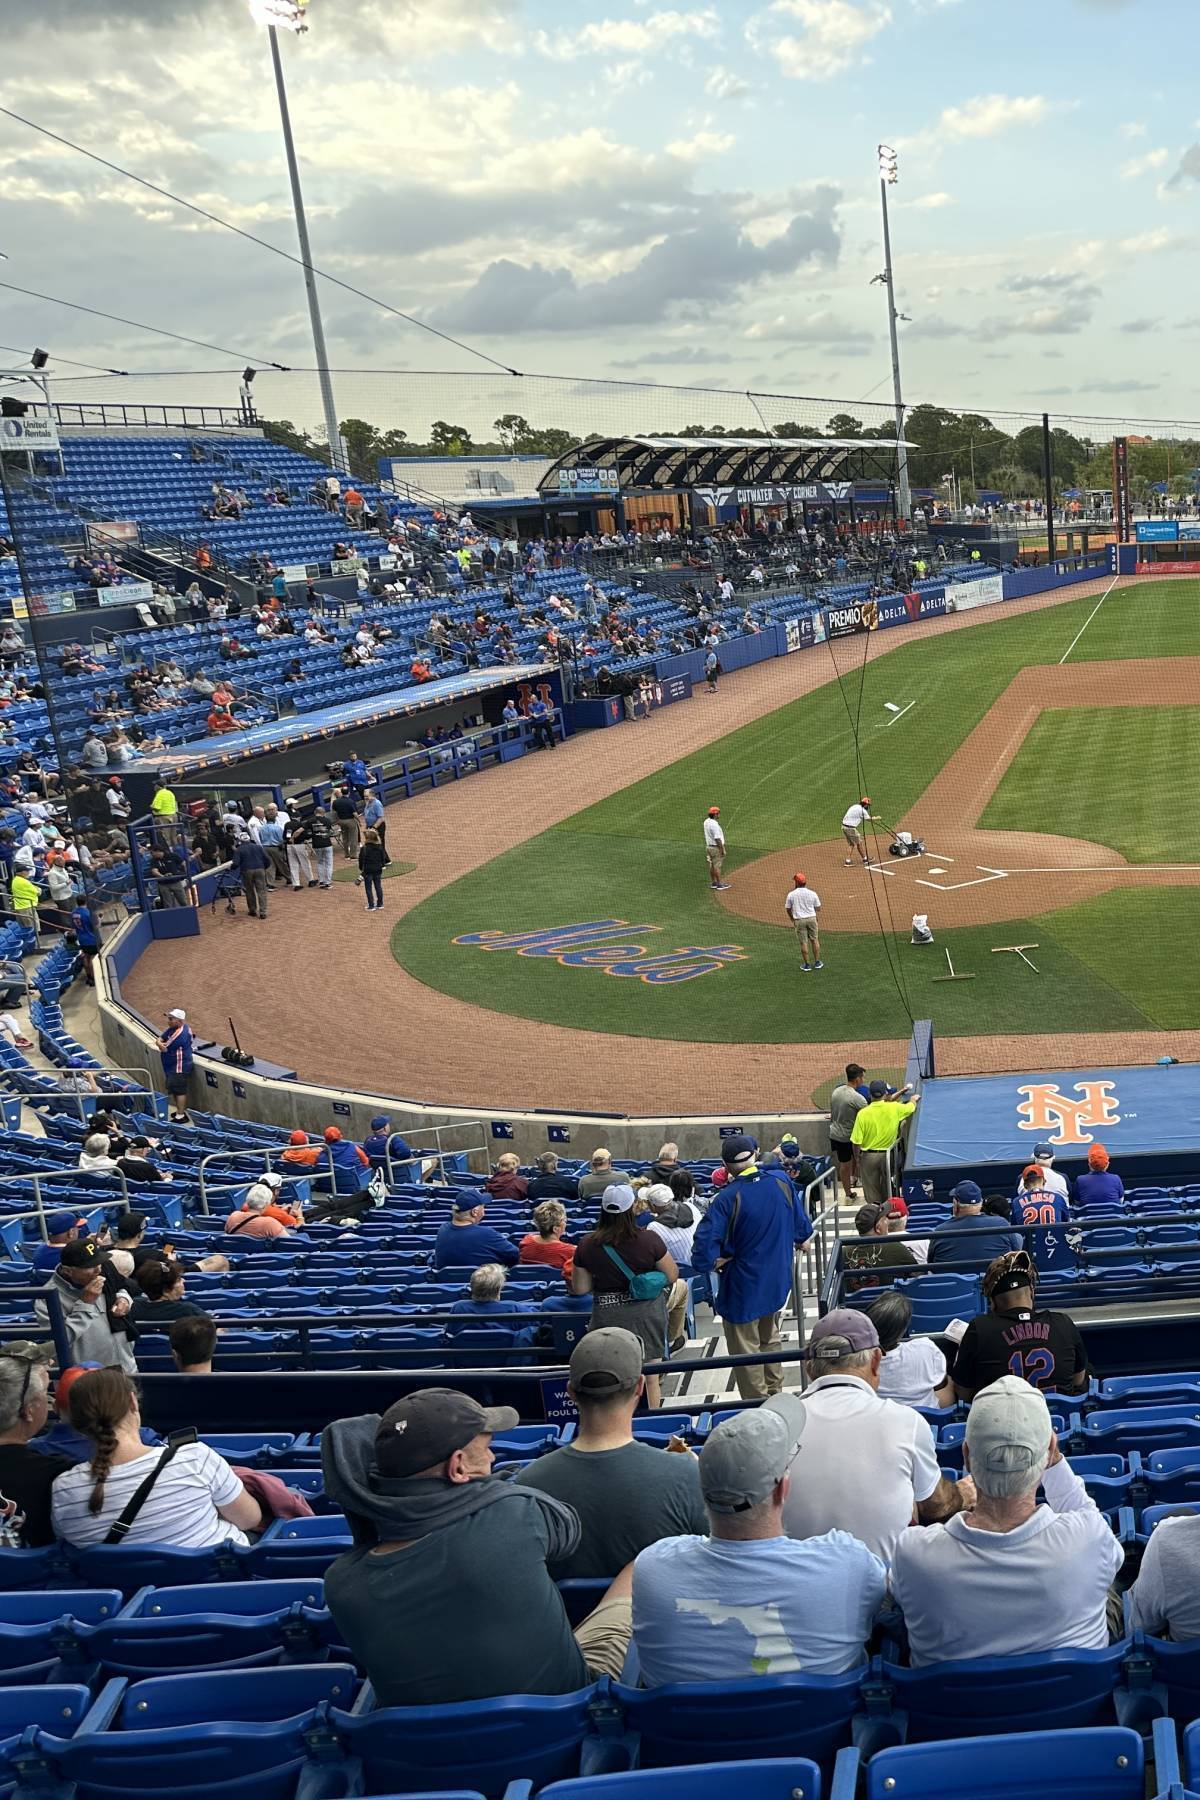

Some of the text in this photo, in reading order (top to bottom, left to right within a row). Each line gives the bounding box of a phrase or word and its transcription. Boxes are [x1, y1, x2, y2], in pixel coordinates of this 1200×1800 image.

[23, 421, 47, 429] United
[737, 488, 773, 503] CUTWATER
[793, 485, 818, 499] CORNER
[926, 598, 946, 611] DELTA
[828, 606, 861, 629] PREMIO
[884, 605, 907, 620] DELTA
[451, 919, 750, 985] Mets
[909, 1186, 915, 1194] 7
[1022, 1204, 1056, 1226] 20
[86, 1243, 95, 1256] P
[1046, 1248, 1056, 1259] 7
[566, 1329, 575, 1342] 8
[1001, 1322, 1050, 1346] LINDOR
[1008, 1347, 1057, 1394] 12
